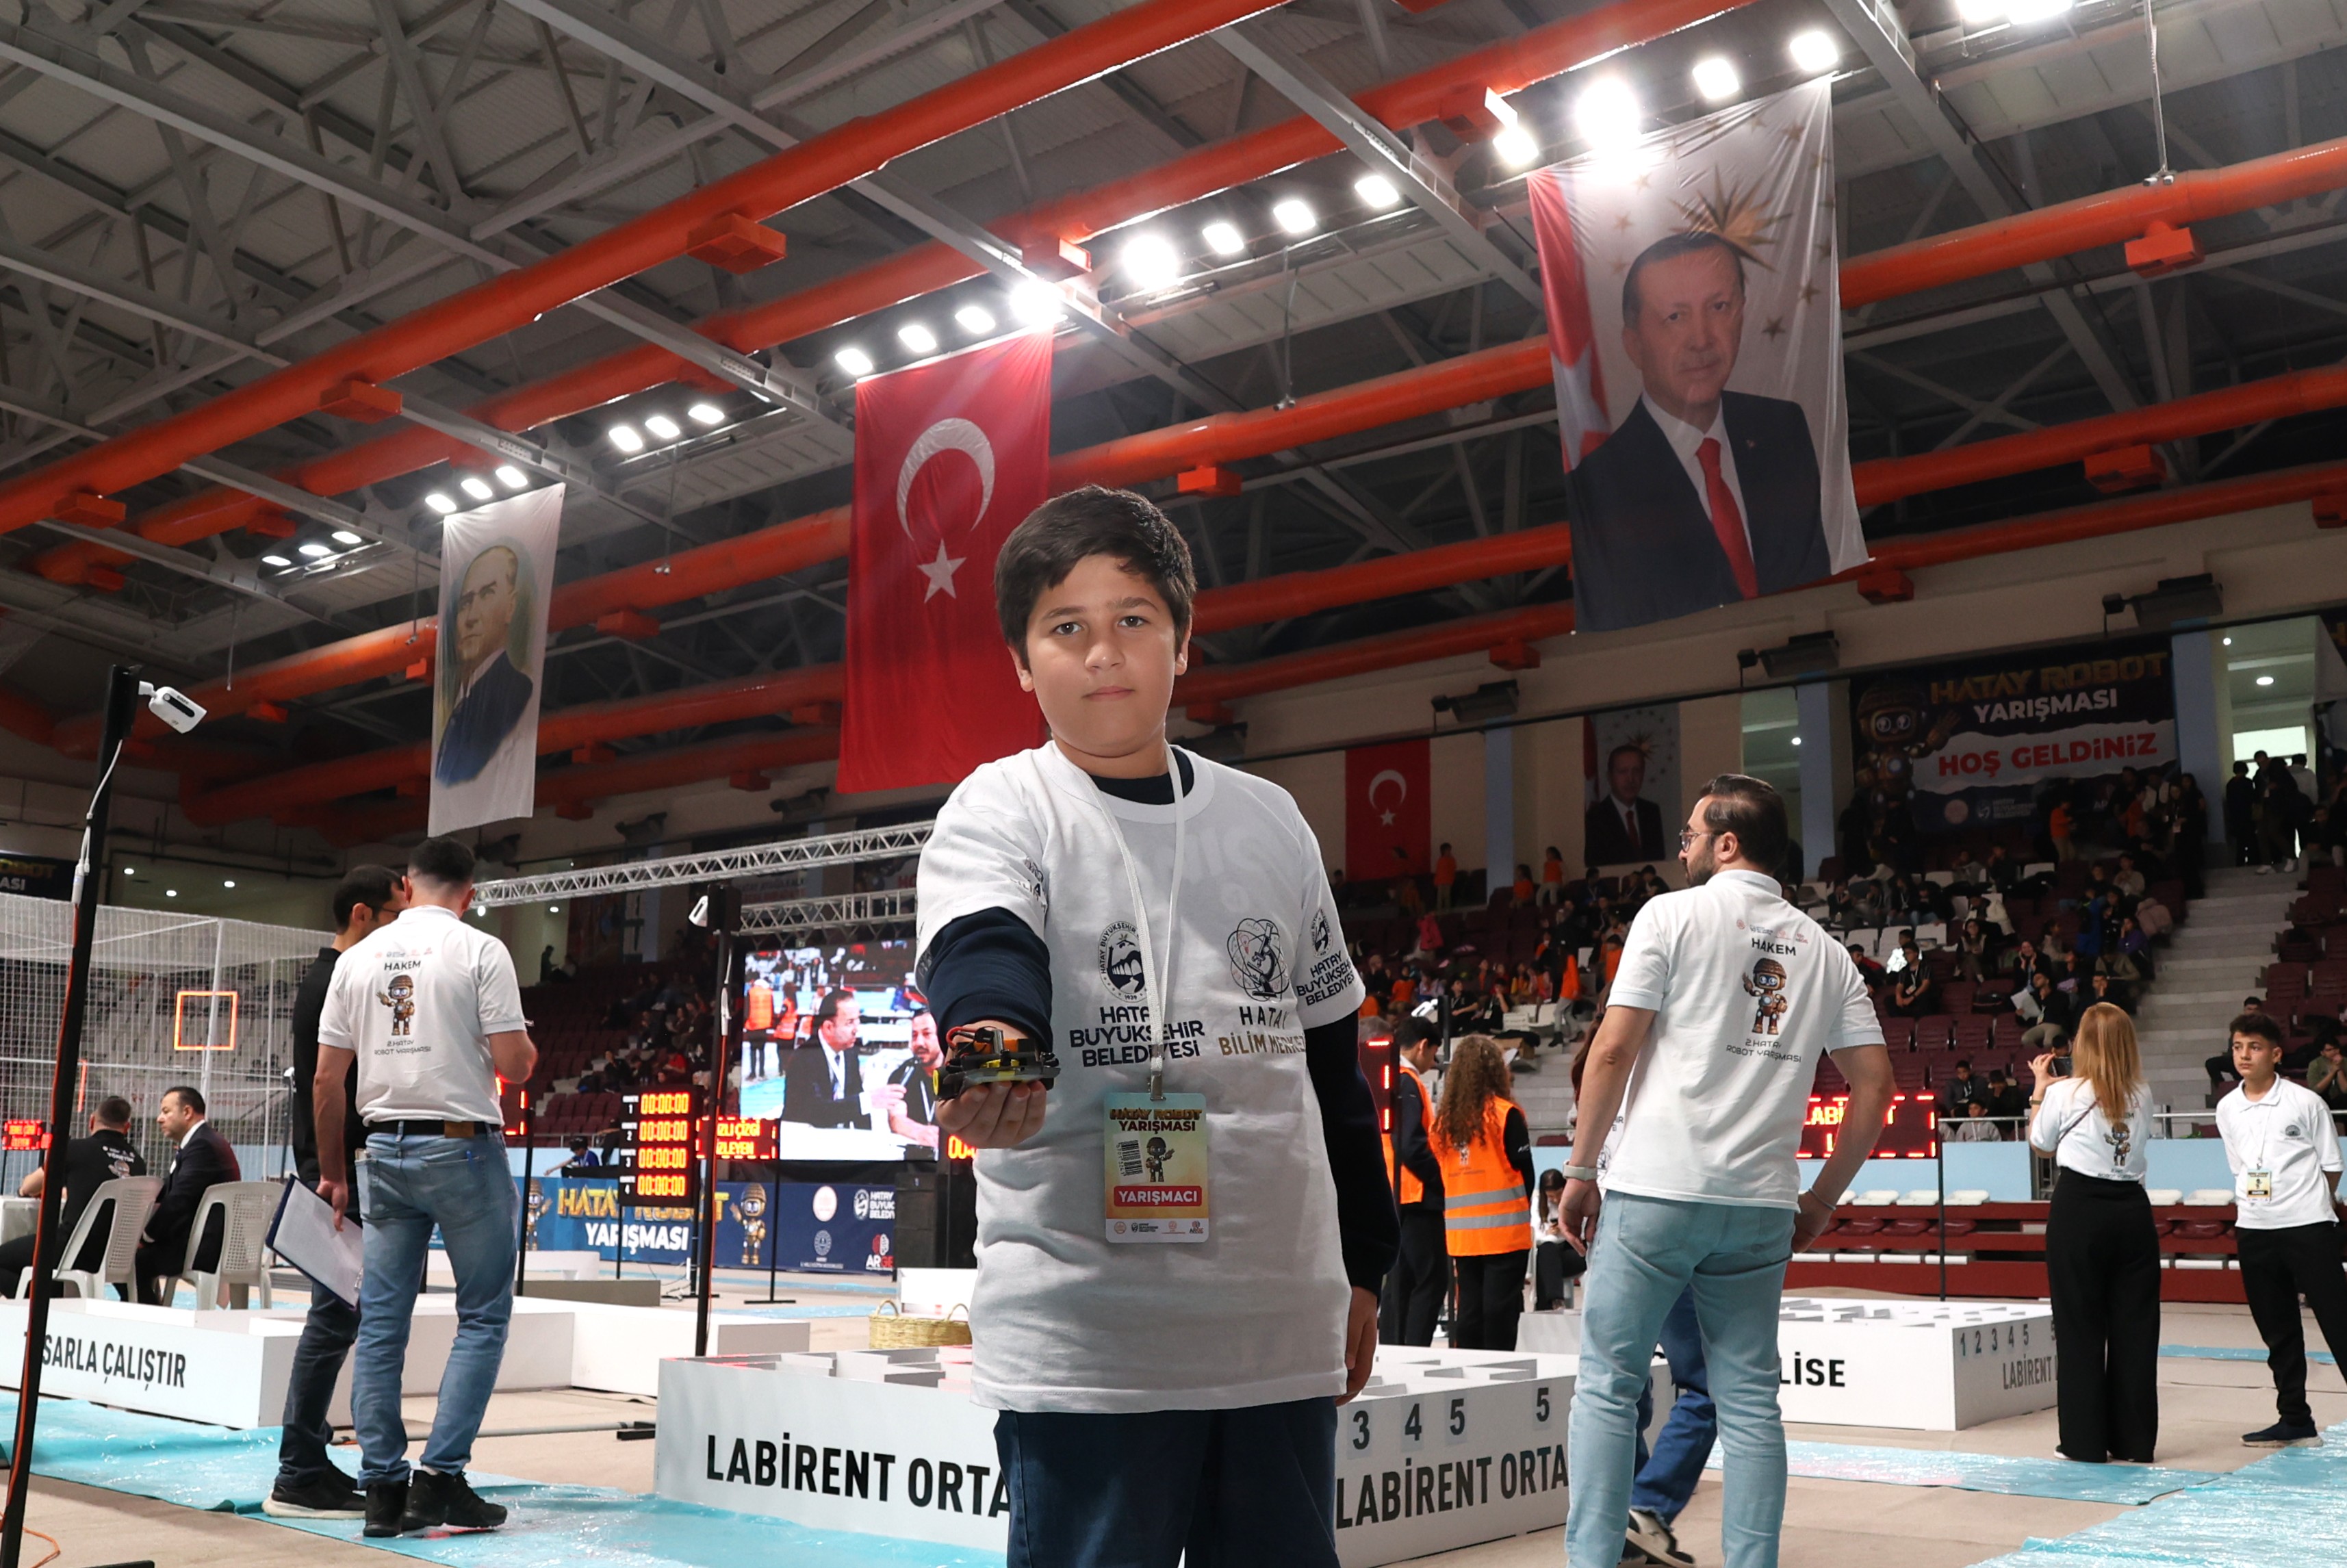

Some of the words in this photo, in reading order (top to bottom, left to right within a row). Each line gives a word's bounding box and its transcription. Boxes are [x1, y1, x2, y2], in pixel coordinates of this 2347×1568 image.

[1931, 669, 2032, 704] HATAY
[2041, 652, 2168, 693] ROBOT
[1973, 688, 2118, 723] YARIŞMASI
[1938, 750, 2001, 778] HOŞ
[2011, 732, 2157, 769] GELDİNİZ
[0, 876, 26, 891] ASI
[1752, 938, 1796, 956] HAKEM
[384, 960, 421, 971] HAKEM
[1310, 950, 1342, 978] HATAY
[1305, 970, 1355, 1006] BELEDİYES
[1100, 1005, 1150, 1024] HATA
[1218, 1031, 1267, 1056] BİLİM
[1268, 1033, 1305, 1053] MERKEZ
[1726, 1044, 1754, 1056] ROBOT
[629, 1104, 633, 1114] 1
[641, 1094, 689, 1115] 00:00:00
[1153, 1109, 1203, 1120] ROBOT
[627, 1131, 632, 1142] 2
[639, 1120, 688, 1142] 00:00:00
[1119, 1120, 1196, 1134] YARIŞMASI
[626, 1157, 631, 1168] 3
[639, 1148, 687, 1168] 00:00:00
[624, 1184, 630, 1195] 4
[637, 1175, 685, 1196] 00:00:00
[1118, 1190, 1198, 1205] YARIŞMACI
[557, 1185, 626, 1220] HATA
[865, 1254, 894, 1268] ARGE
[1960, 1333, 1966, 1357] 1
[1975, 1330, 1982, 1354] 2
[1992, 1328, 1998, 1351] 3
[2008, 1326, 2014, 1348] 4
[2023, 1324, 2029, 1346] 5
[41, 1334, 97, 1373] SARLA
[103, 1343, 187, 1391] ÇALIŞTIR
[1779, 1351, 1845, 1387] LİSE
[2003, 1354, 2052, 1390] LABİRENT
[1535, 1387, 1550, 1422] 5
[1352, 1410, 1370, 1450] 3
[1405, 1403, 1422, 1441] 4
[1450, 1398, 1465, 1436] 5
[706, 1432, 896, 1502] LABİRENT
[1336, 1457, 1492, 1530] LABİRENT
